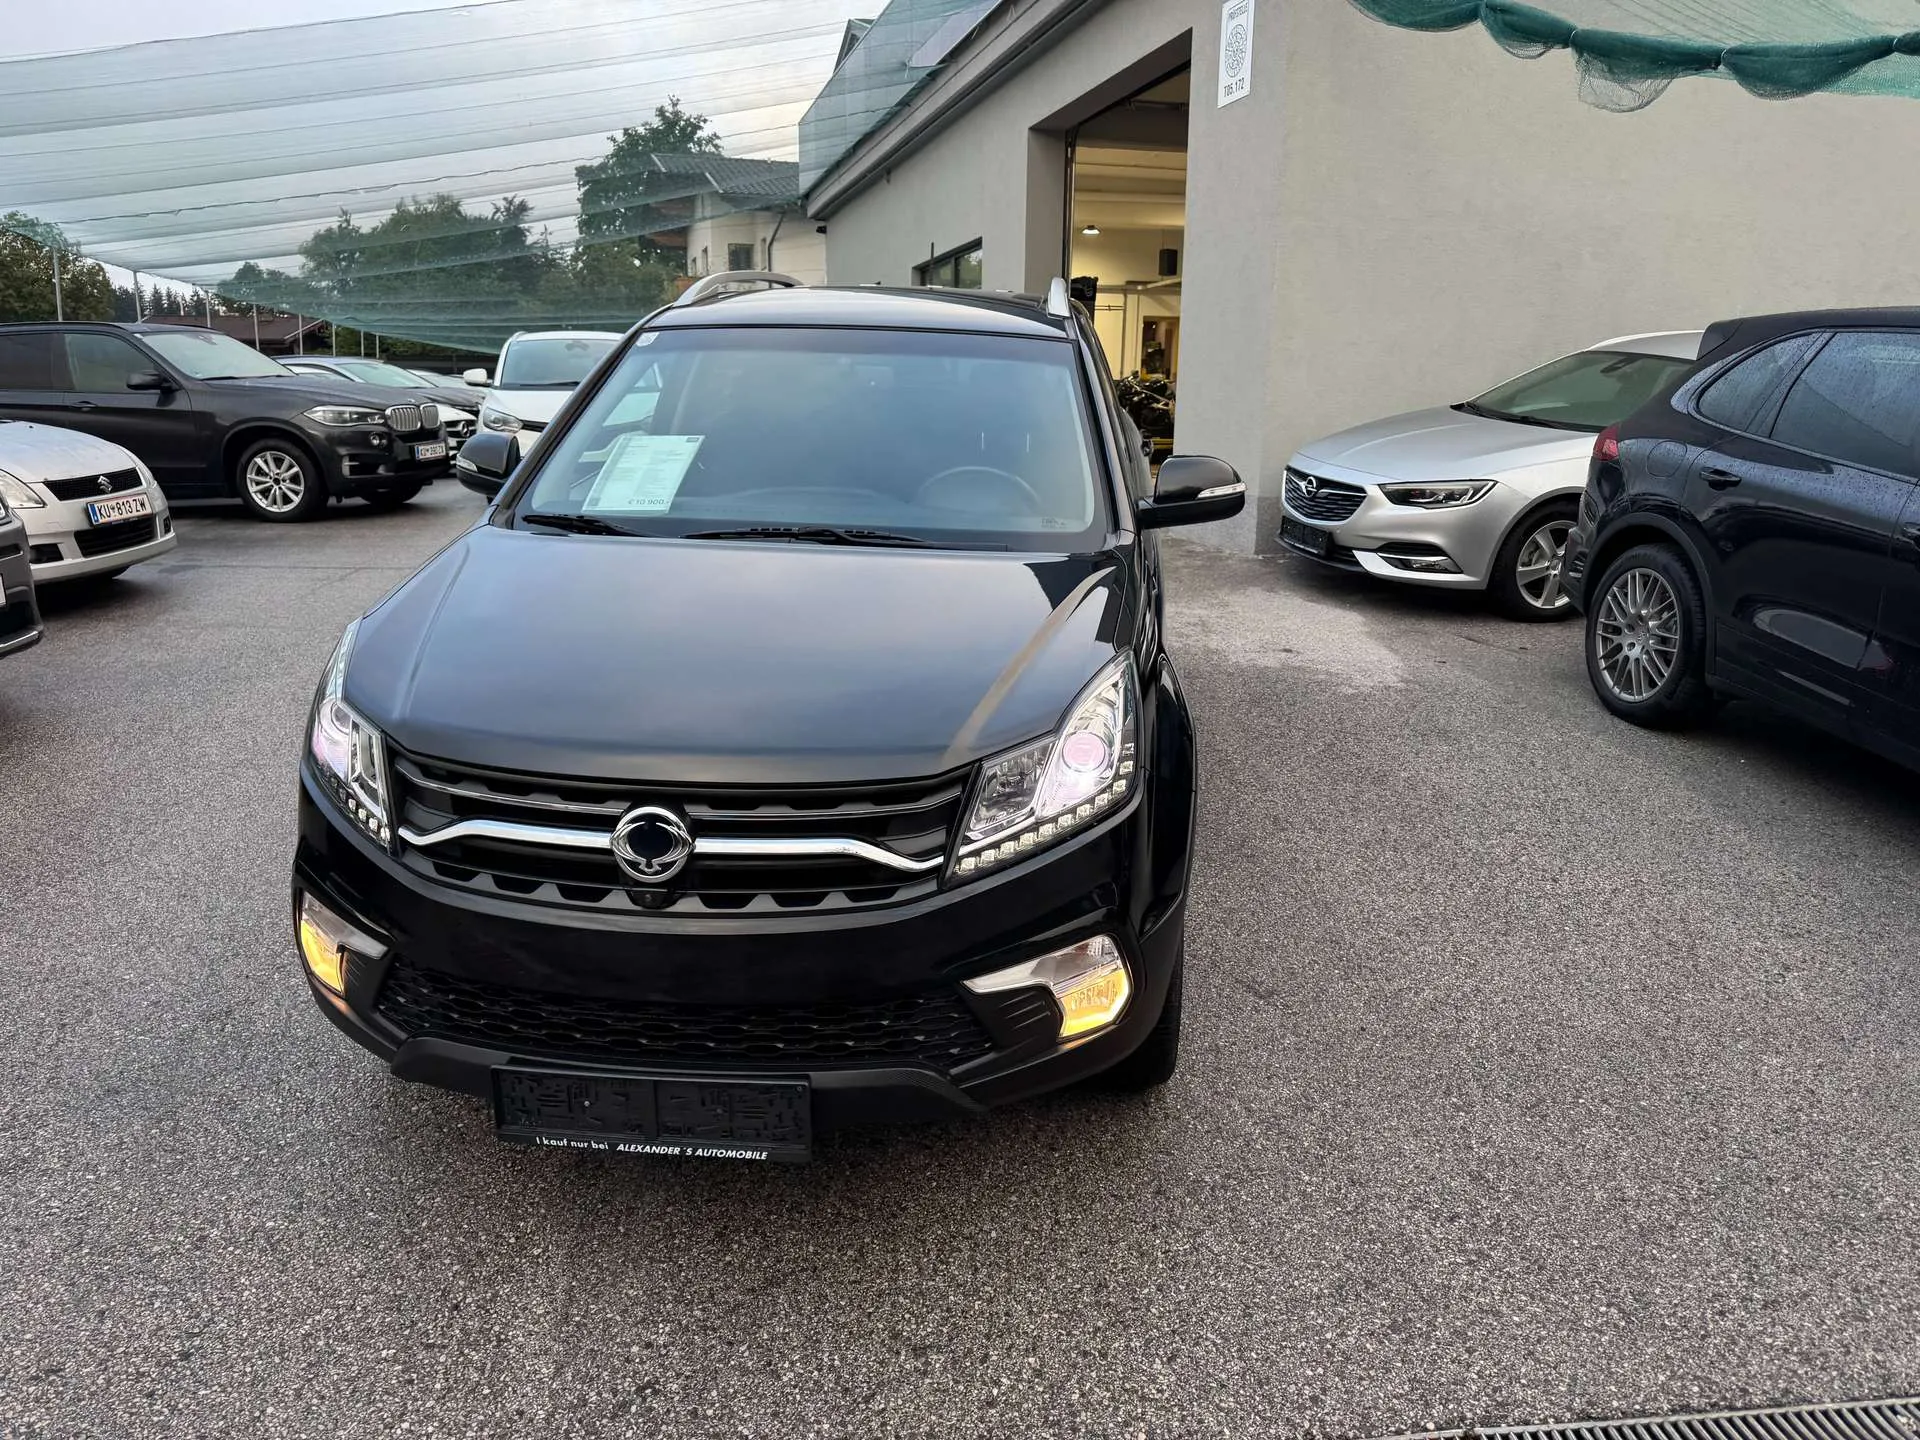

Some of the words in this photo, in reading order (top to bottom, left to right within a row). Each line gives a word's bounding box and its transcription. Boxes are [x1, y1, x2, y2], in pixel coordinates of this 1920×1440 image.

[97, 504, 111, 520] KU
[116, 500, 133, 516] 813
[133, 498, 147, 513] ZW
[542, 1137, 568, 1148] kauf
[570, 1140, 588, 1149] nur
[591, 1140, 609, 1150] bei
[616, 1143, 681, 1156] ALEXANDER
[695, 1148, 768, 1161] AUTOMOBILE
